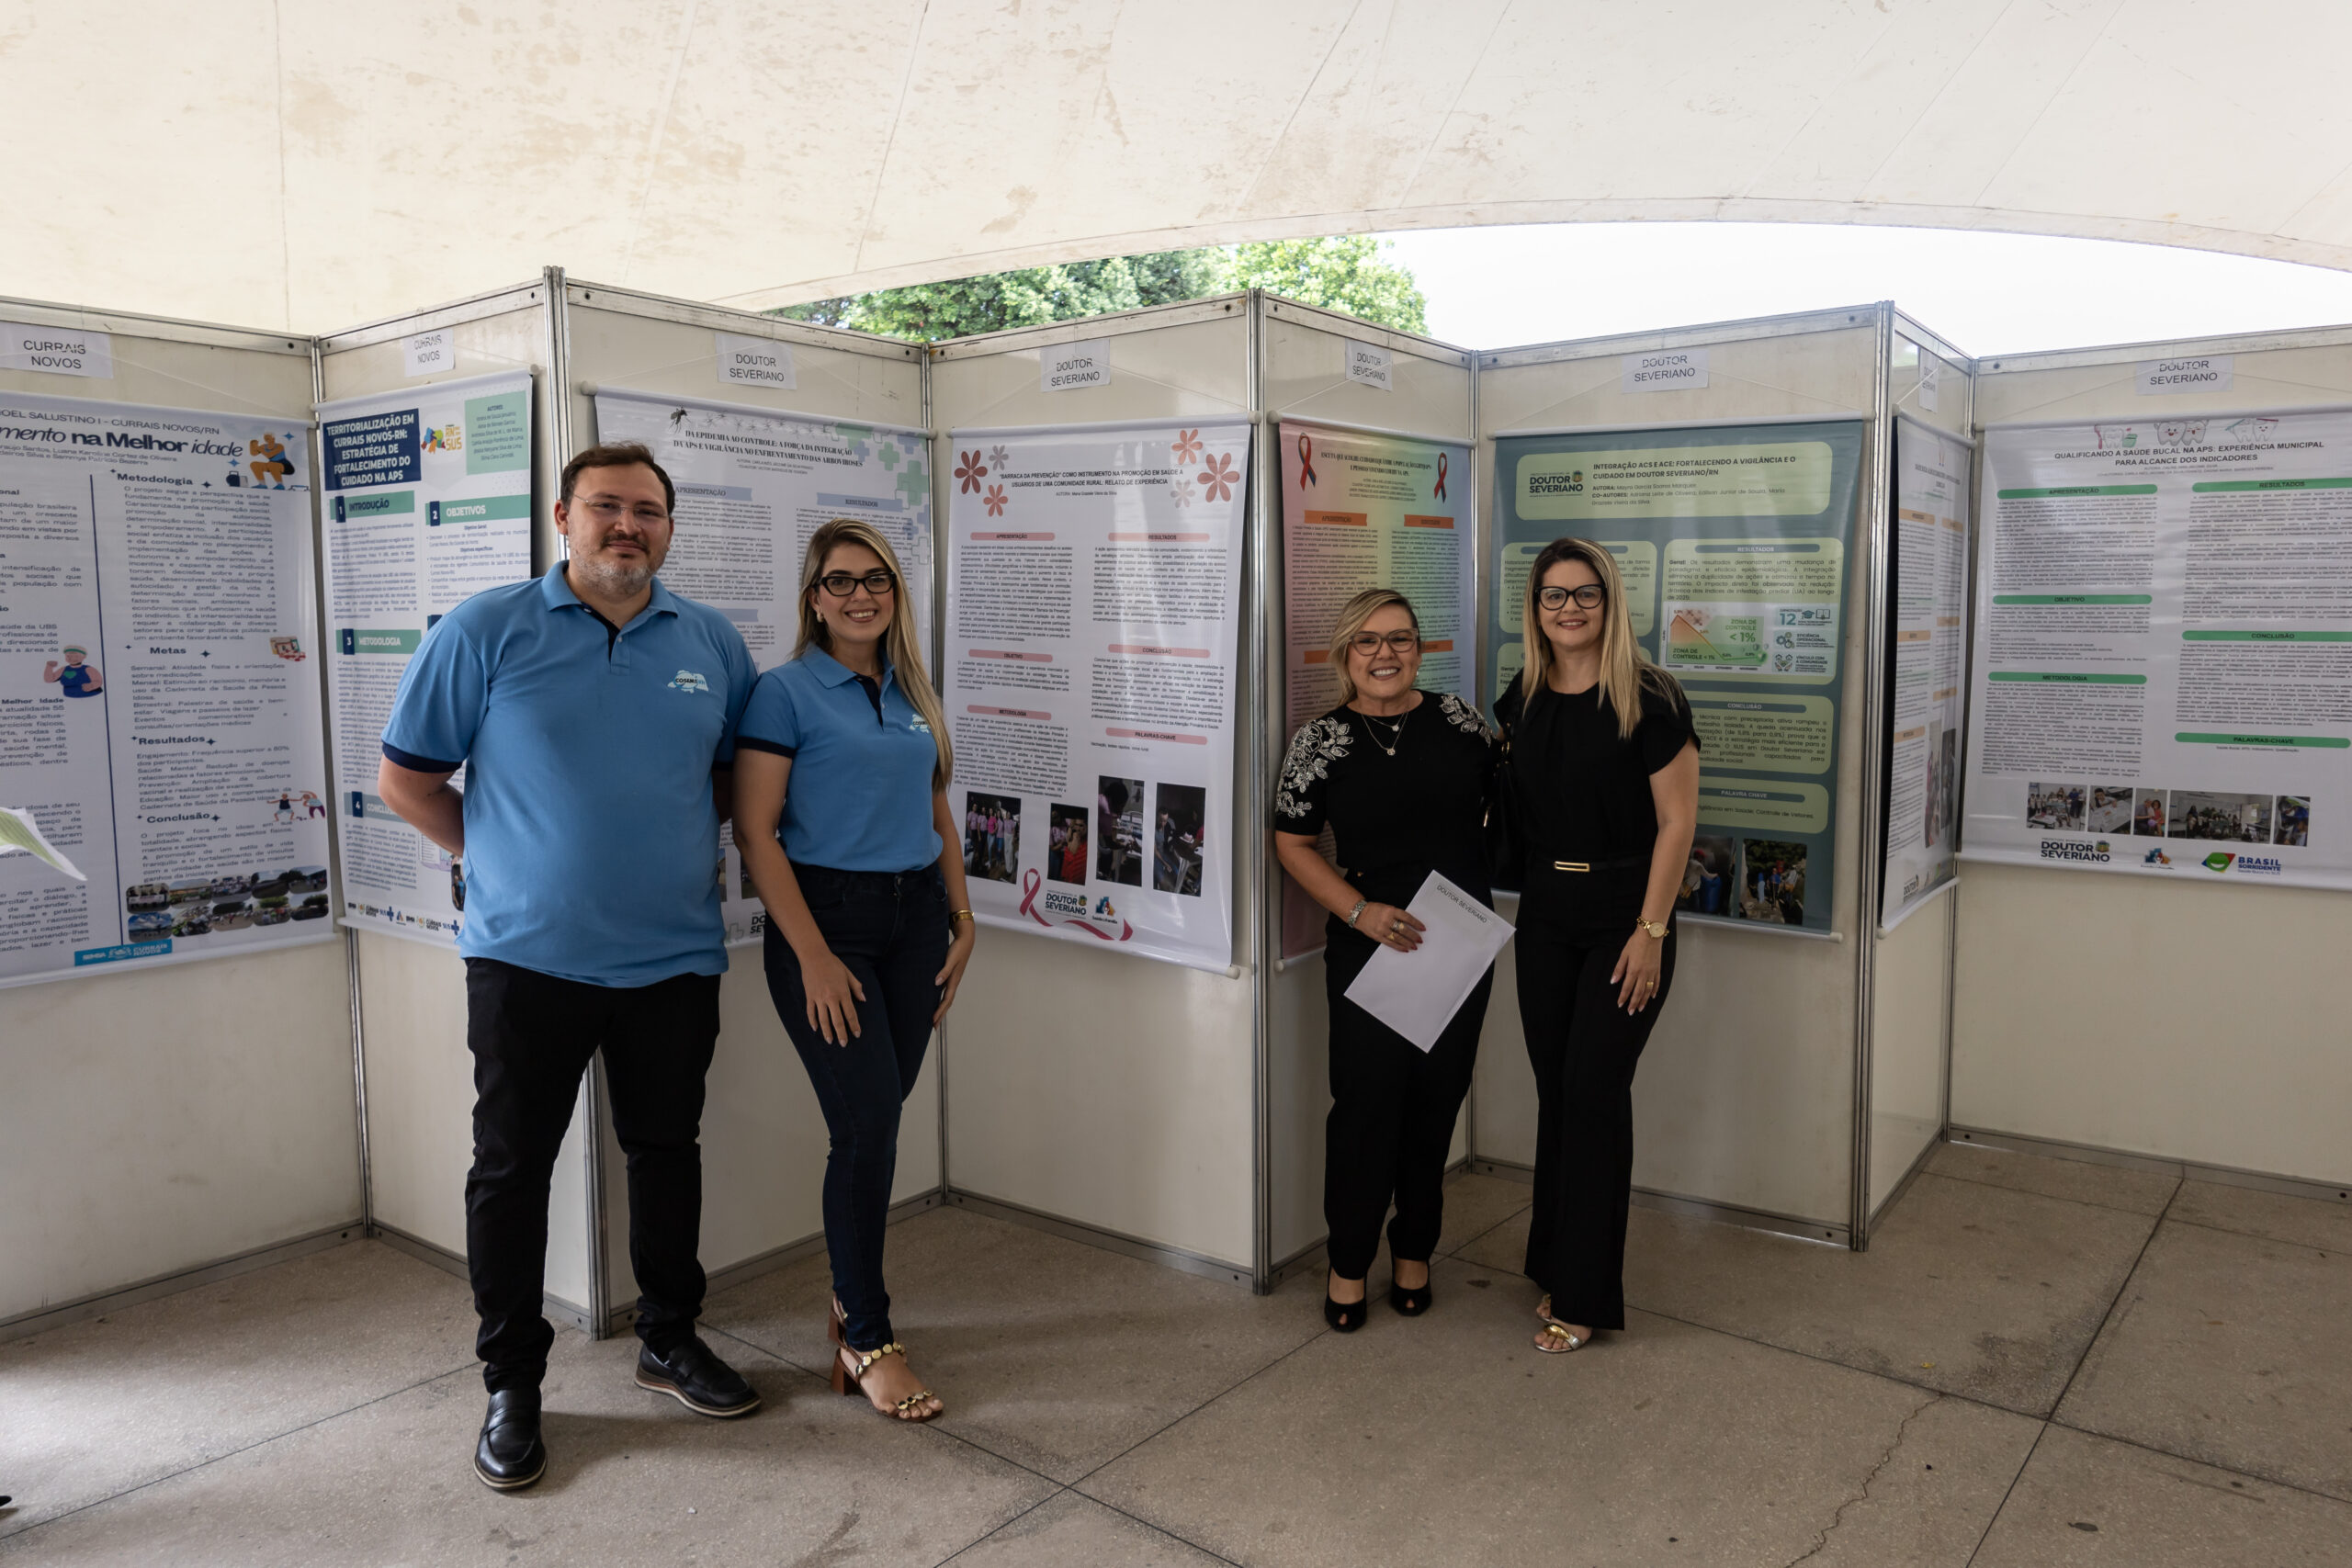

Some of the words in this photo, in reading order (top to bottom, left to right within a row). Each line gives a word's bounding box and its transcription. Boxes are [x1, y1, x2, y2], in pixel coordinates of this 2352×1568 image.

[23, 338, 86, 356] CURRAIS
[414, 334, 441, 351] CURRAIS
[31, 355, 82, 371] NOVOS
[418, 350, 440, 363] NOVOS
[735, 353, 776, 367] DOUTOR
[1357, 353, 1381, 365] DOUTOR
[1643, 354, 1688, 369] DOUTOR
[1057, 357, 1092, 373] DOUTOR
[2159, 359, 2209, 373] DOUTOR
[729, 367, 784, 382] SEVERIANO
[1051, 370, 1100, 388] SEVERIANO
[1352, 365, 1385, 381] SEVERIANO
[1634, 367, 1695, 384] SEVERIANO
[2150, 371, 2217, 387] SEVERIANO
[0, 409, 25, 419] OEL
[28, 412, 95, 425] SALUSTINO
[111, 418, 159, 430] CURRAIS
[163, 423, 219, 435] NOVOS/RN
[327, 415, 400, 437] TERRITORIALIZAÇÃO
[402, 413, 413, 426] EM
[72, 432, 102, 447] na
[107, 434, 187, 454] Melhor
[191, 440, 243, 457] idade
[334, 434, 364, 448] CURRAIS
[366, 429, 407, 445] NOVOS-RN:
[446, 437, 462, 450] SUS
[685, 430, 694, 439] DA
[695, 431, 729, 443] EPIDEMIA
[731, 434, 739, 445] AO
[741, 435, 776, 448] CONTROLE:
[779, 440, 782, 449] A
[784, 441, 803, 451] FORÇA
[805, 443, 812, 452] DA
[814, 444, 852, 457] INTEGRAÇÃO
[342, 445, 386, 460] ESTRATÉGIA
[388, 443, 399, 456] DE
[673, 439, 682, 448] DA
[685, 441, 696, 450] APS
[698, 442, 702, 450] E
[705, 443, 742, 455] VIGILÂNCIA
[744, 446, 752, 456] NO
[754, 448, 808, 462] ENFRENTAMENTO
[809, 454, 820, 463] DAS
[823, 456, 863, 468] ARBOVIROSES
[2054, 449, 2113, 459] QUALIFICANDO
[2115, 449, 2120, 457] A
[2122, 447, 2149, 457] SAÚDE
[2153, 446, 2178, 456] BUCAL
[2183, 446, 2194, 455] NA
[2197, 445, 2216, 454] APS:
[2218, 443, 2274, 453] EXPERIÊNCIA
[2277, 441, 2324, 451] MUNICIPAL
[334, 457, 397, 474] FORTALECIMENTO
[399, 456, 410, 467] DO
[1593, 461, 1636, 470] INTEGRAÇÃO
[1659, 460, 1674, 468] ACE:
[1676, 458, 1731, 468] FORTALECENDO
[1740, 457, 1781, 465] VIGILÂNCIA
[2139, 457, 2177, 465] ALCANCE
[2179, 456, 2197, 464] DOS
[2199, 454, 2257, 463] INDICADORES
[118, 472, 192, 487] Metodologia
[342, 473, 372, 487] CUIDADO
[375, 472, 385, 483] NA
[388, 470, 402, 481] APS
[1023, 471, 1029, 479] DA
[1062, 470, 1076, 479] COMO
[1078, 470, 1111, 479] INSTRUMENTO
[1113, 469, 1119, 478] NA
[1121, 468, 1150, 478] PROMOÇÃO
[1152, 468, 1159, 477] EM
[1160, 468, 1177, 477] SAÚDE
[1531, 476, 1570, 485] DOUTOR
[1636, 470, 1664, 479] DOUTOR
[1666, 468, 1718, 478] SEVERIANO/RN
[675, 486, 726, 498] APRESENTAÇÃO
[1529, 483, 1583, 493] SEVERIANO
[349, 498, 390, 513] INTRODUÇÃO
[433, 511, 437, 520] 2
[447, 505, 486, 517] OBJETIVOS
[1780, 614, 1796, 625] 12
[347, 637, 351, 645] 3
[358, 637, 401, 647] METODOLOGIA
[1740, 632, 1755, 643] 1%
[150, 647, 187, 655] Metas
[1143, 647, 1171, 655] CONCLUSÃO
[139, 735, 205, 746] Resultados
[147, 810, 209, 824] Conclusão
[2041, 841, 2093, 852] DOUTOR
[2041, 850, 2109, 863] SEVERIANO
[2238, 856, 2280, 865] BRASIL
[1046, 893, 1077, 906] DOUTOR
[1437, 885, 1459, 904] DOUTOR
[1459, 900, 1487, 923] SEVERIANO
[1046, 900, 1086, 915] SEVERIANO
